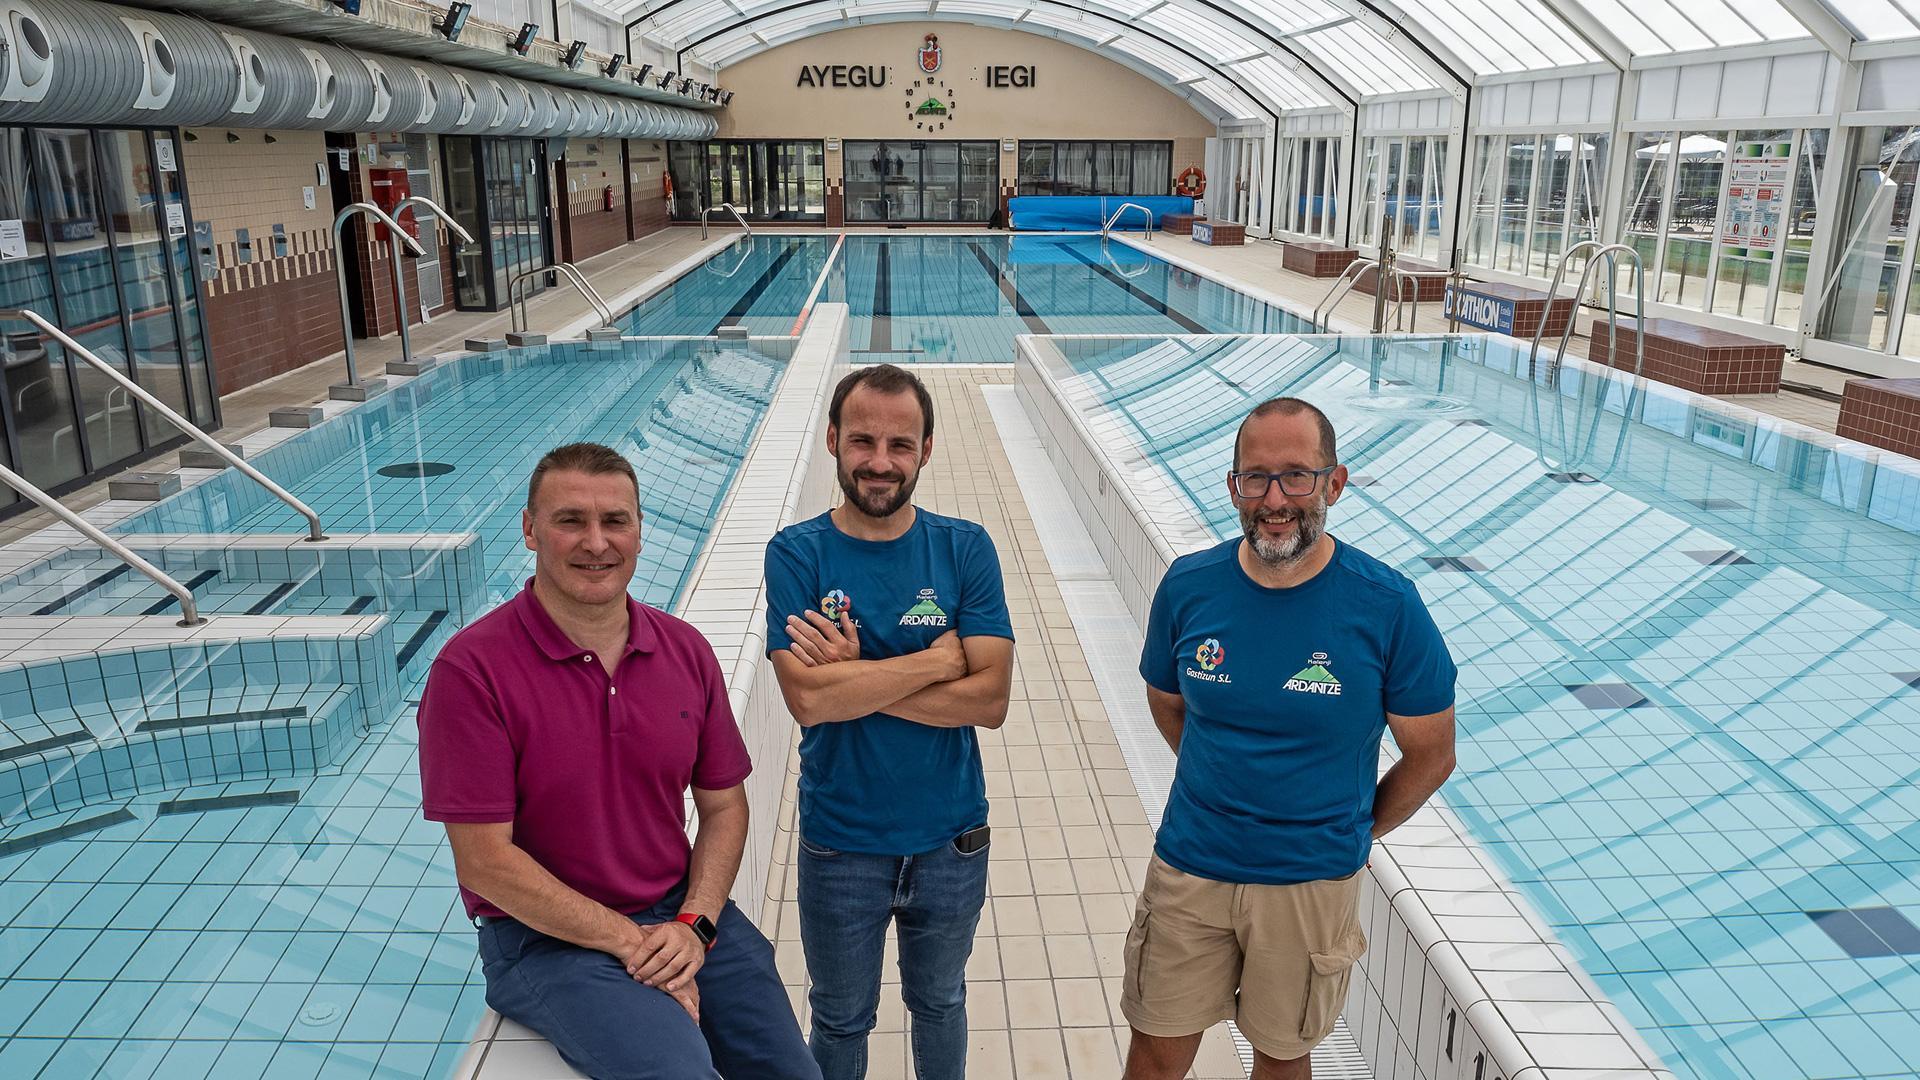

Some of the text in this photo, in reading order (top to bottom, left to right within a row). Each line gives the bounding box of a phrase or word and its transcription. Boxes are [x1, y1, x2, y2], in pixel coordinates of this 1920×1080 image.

[797, 65, 1036, 87] AYEGU IEGI
[1446, 289, 1500, 328] DCATHLON
[899, 615, 947, 626] ARDANTZE
[1186, 667, 1216, 682] Gastizun
[1282, 678, 1342, 696] ARDANTZE
